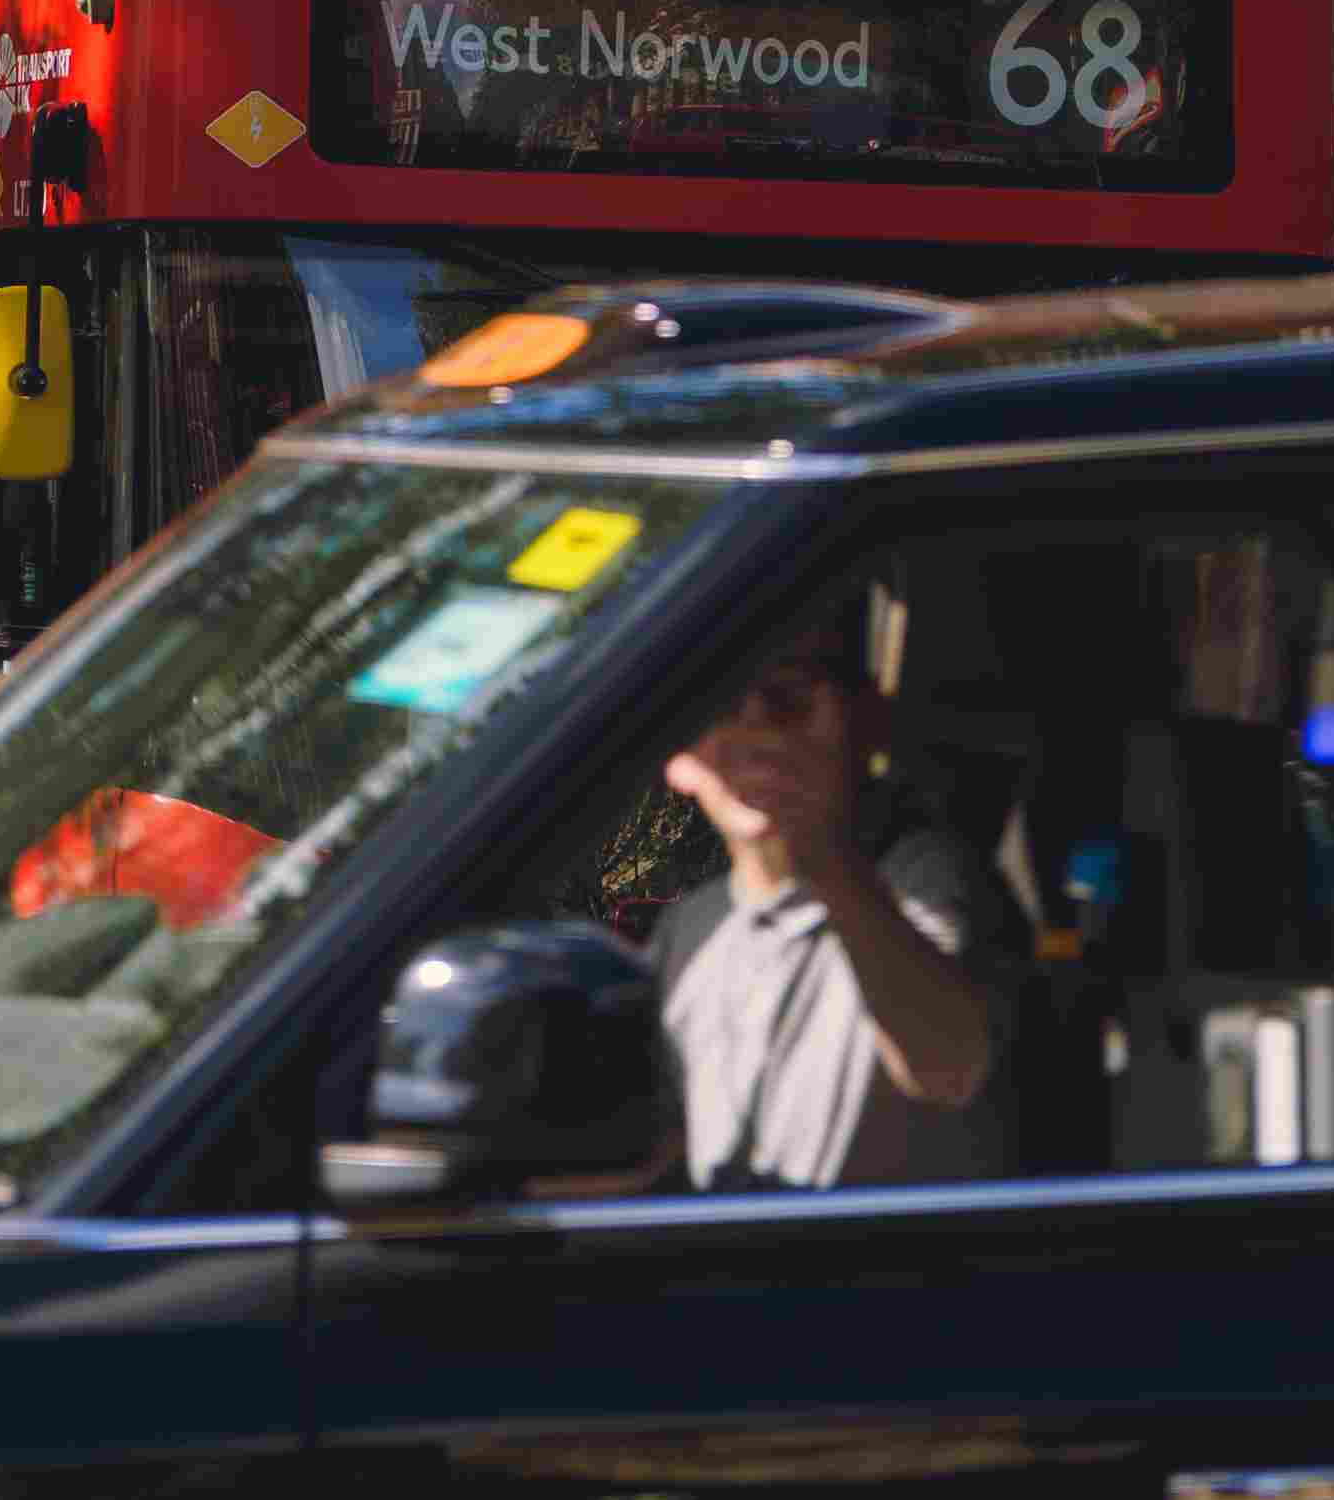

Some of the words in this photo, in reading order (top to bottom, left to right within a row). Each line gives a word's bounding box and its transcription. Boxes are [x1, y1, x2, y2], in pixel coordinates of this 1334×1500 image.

[17, 48, 72, 81] TRANSPORT
[381, 0, 551, 75] West
[580, 8, 869, 88] Norwood
[989, 0, 1147, 128] 68
